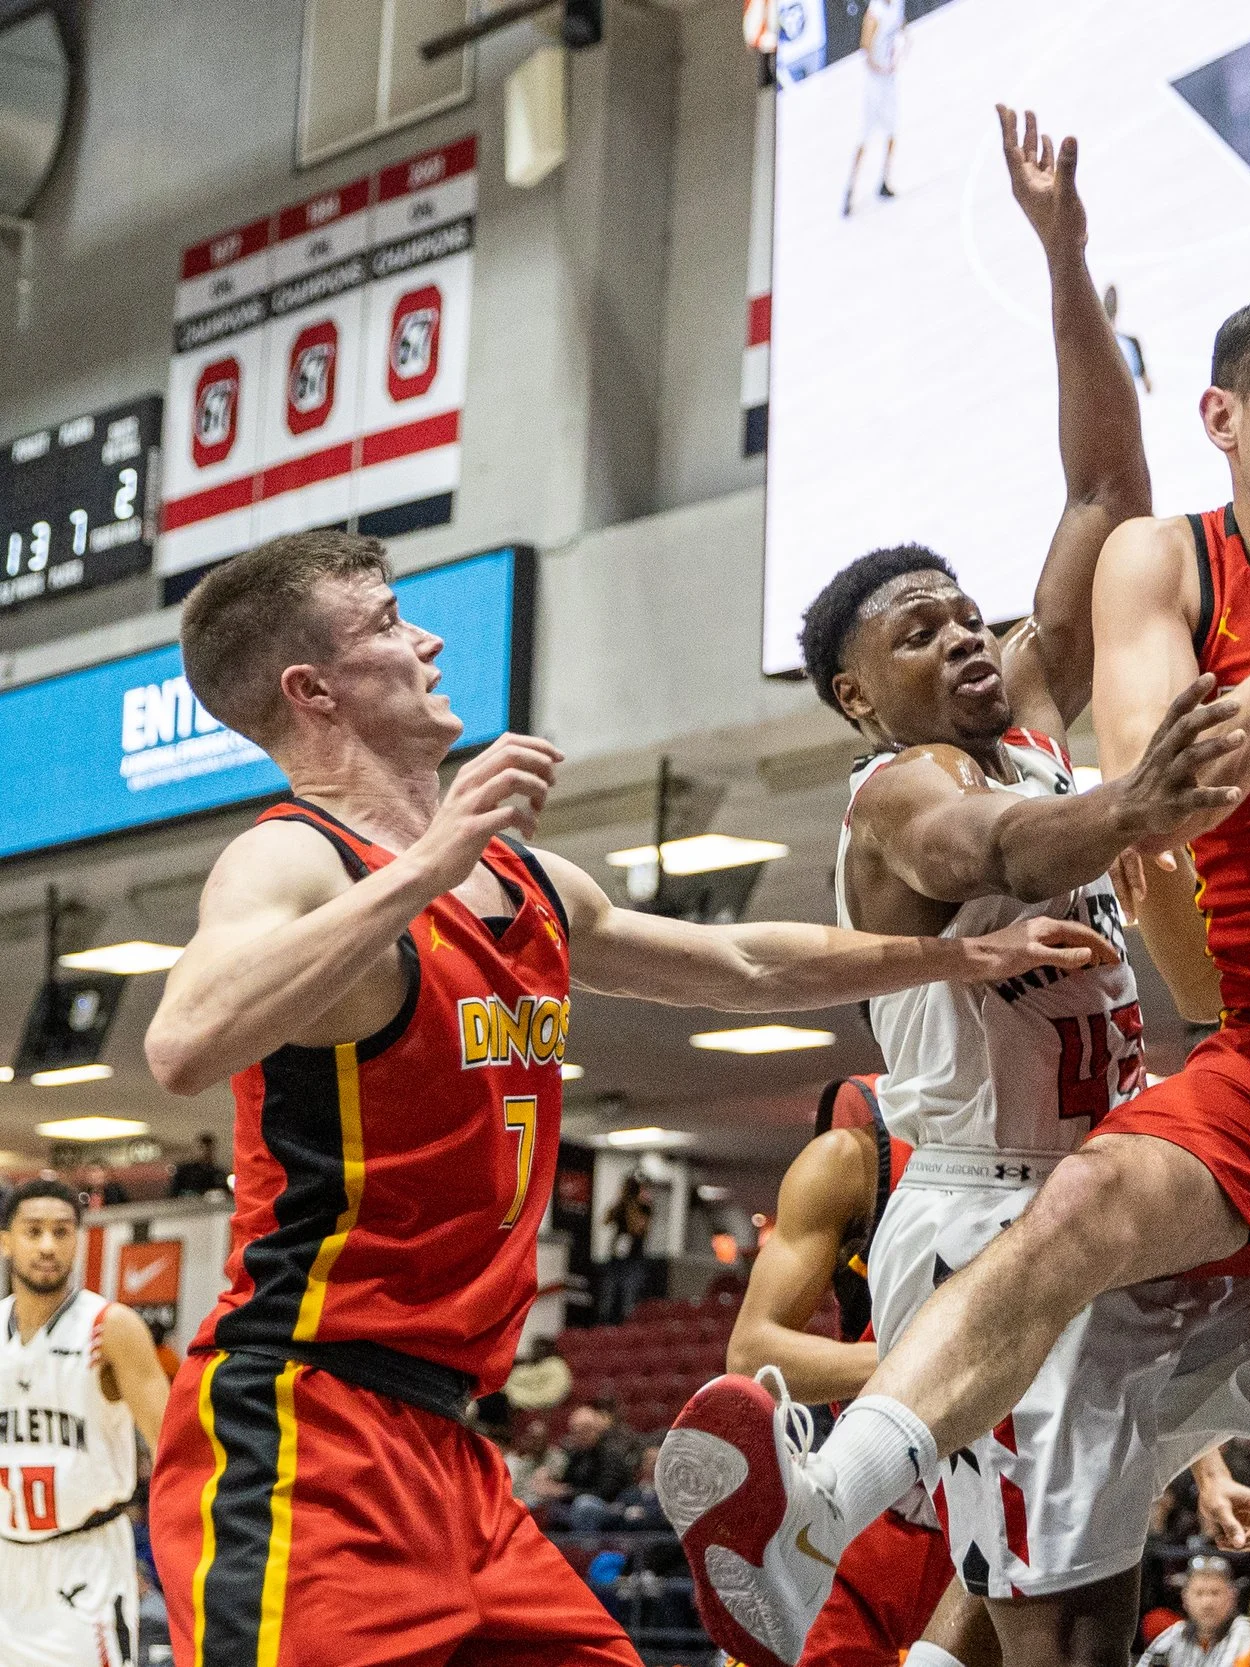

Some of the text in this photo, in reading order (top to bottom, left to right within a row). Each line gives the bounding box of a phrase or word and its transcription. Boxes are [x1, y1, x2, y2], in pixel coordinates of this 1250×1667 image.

[114, 468, 138, 520] 2
[456, 993, 572, 1071] DINOS
[498, 1094, 538, 1230] 7
